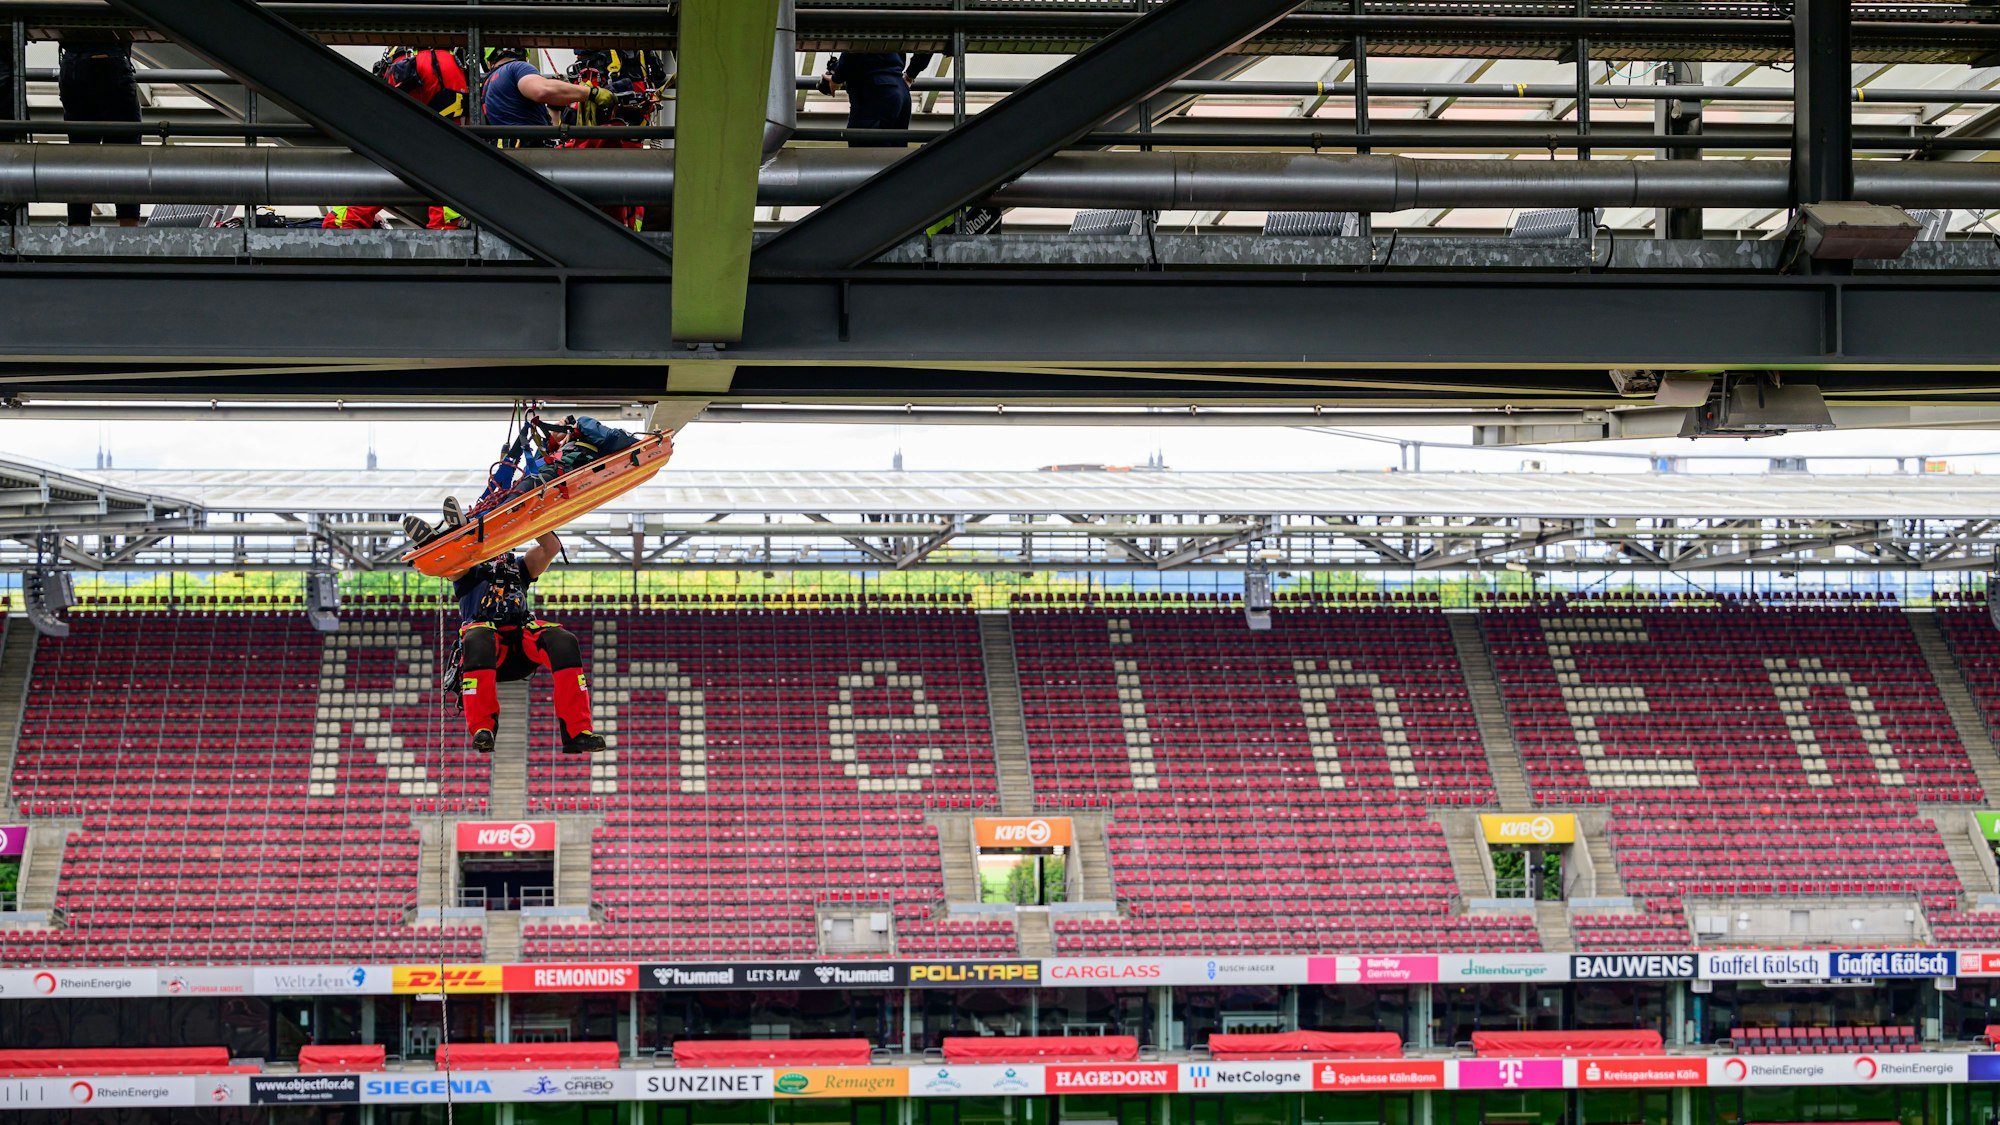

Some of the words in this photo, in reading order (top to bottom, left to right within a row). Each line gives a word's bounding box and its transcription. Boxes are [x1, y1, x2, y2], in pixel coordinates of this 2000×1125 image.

[994, 825, 1026, 841] KVB
[1500, 821, 1530, 836] KVB
[477, 829, 510, 845] KVB
[1460, 958, 1548, 977] dillenburger
[1575, 955, 1694, 979] BAUWENS
[1709, 955, 1757, 976] Gaffel
[1763, 954, 1819, 975] Kölsch
[1837, 953, 1890, 975] Gaffel
[1894, 952, 1949, 975] Kölsch
[274, 972, 344, 988] Weltzien
[407, 970, 486, 987] DHL
[673, 968, 734, 985] hummel
[746, 969, 773, 982] LET'S
[776, 968, 800, 982] PLAY
[834, 966, 894, 983] hummel
[909, 964, 1039, 981] POLI-TAPE
[1051, 965, 1161, 979] CARGLASS
[1366, 967, 1411, 980] Germany
[60, 977, 132, 990] RheinEnergie
[1603, 1068, 1673, 1083] Kreissparkasse
[1676, 1067, 1700, 1081] Köln
[1751, 1063, 1825, 1078] RheinEnergie
[1881, 1062, 1954, 1077] RheinEnergie
[255, 1077, 355, 1093] www.objectflor.de
[564, 1080, 614, 1090] CARBO
[647, 1074, 764, 1093] SUNZINET
[825, 1074, 895, 1092] Remagen
[1056, 1069, 1168, 1087] HAGEDORN
[1216, 1070, 1301, 1086] NetCologne
[1338, 1072, 1388, 1086] Sparkasse
[1389, 1070, 1437, 1084] KölnBonn
[97, 1085, 169, 1099] RheinEnergie
[366, 1079, 492, 1095] SIEGENIA
